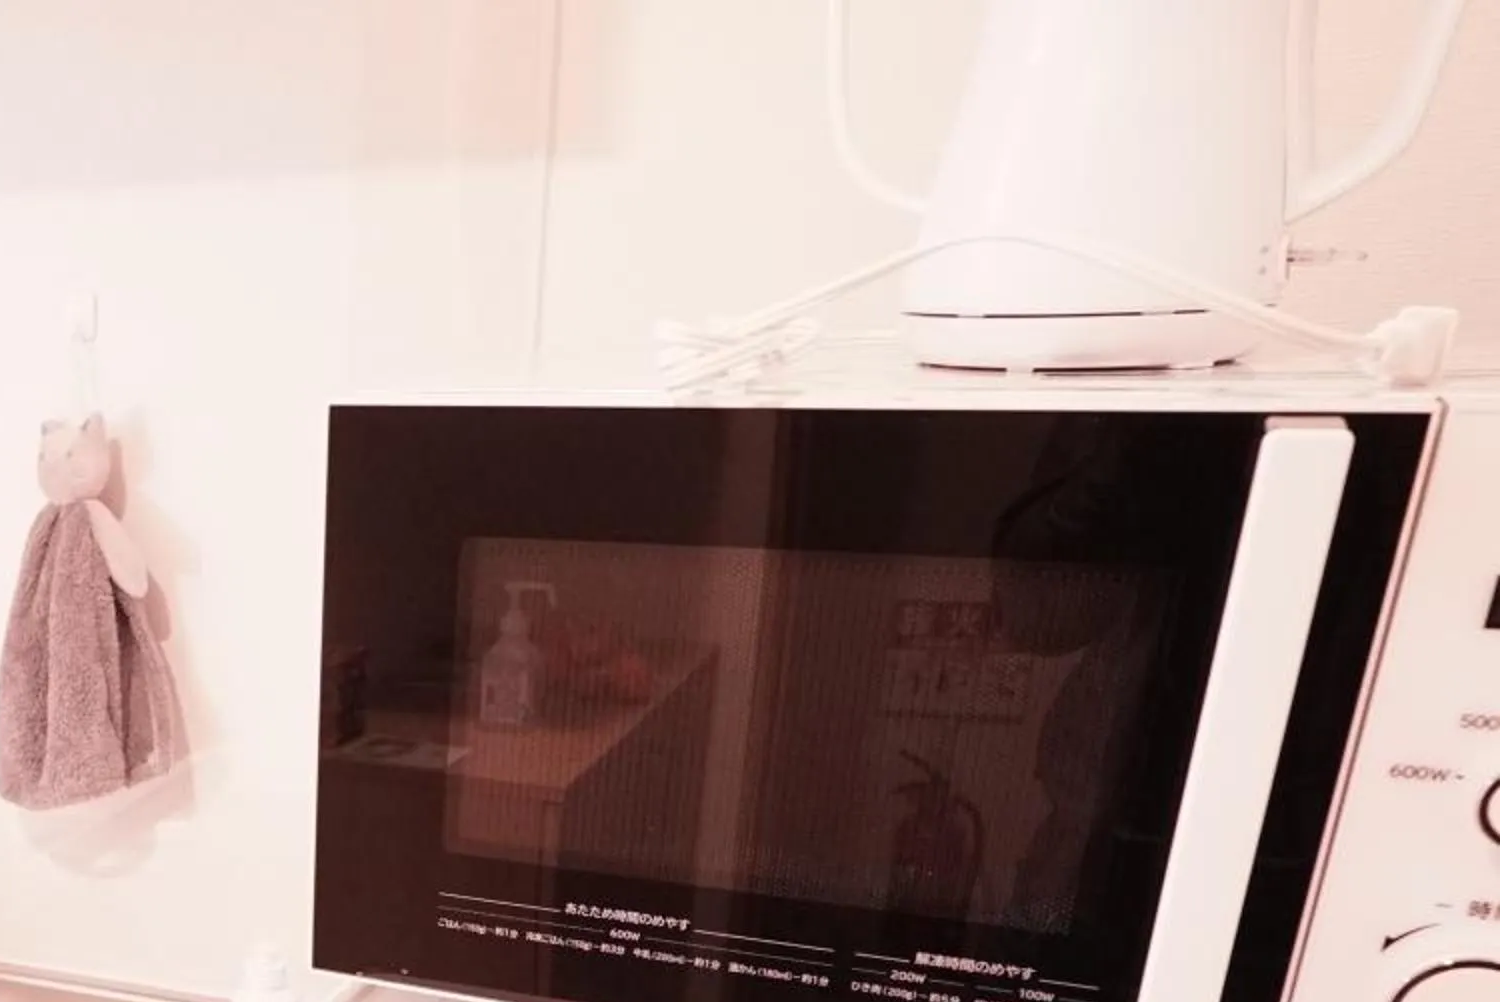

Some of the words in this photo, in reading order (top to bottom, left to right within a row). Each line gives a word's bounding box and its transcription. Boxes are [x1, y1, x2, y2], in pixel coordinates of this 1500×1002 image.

[1389, 763, 1450, 783] 600W
[565, 902, 691, 932] あたため時間のめやす
[609, 928, 641, 942] 600W
[914, 951, 1038, 981] 解凍時間のめやす
[889, 969, 927, 985] 200W
[1019, 987, 1056, 1002] 100W
